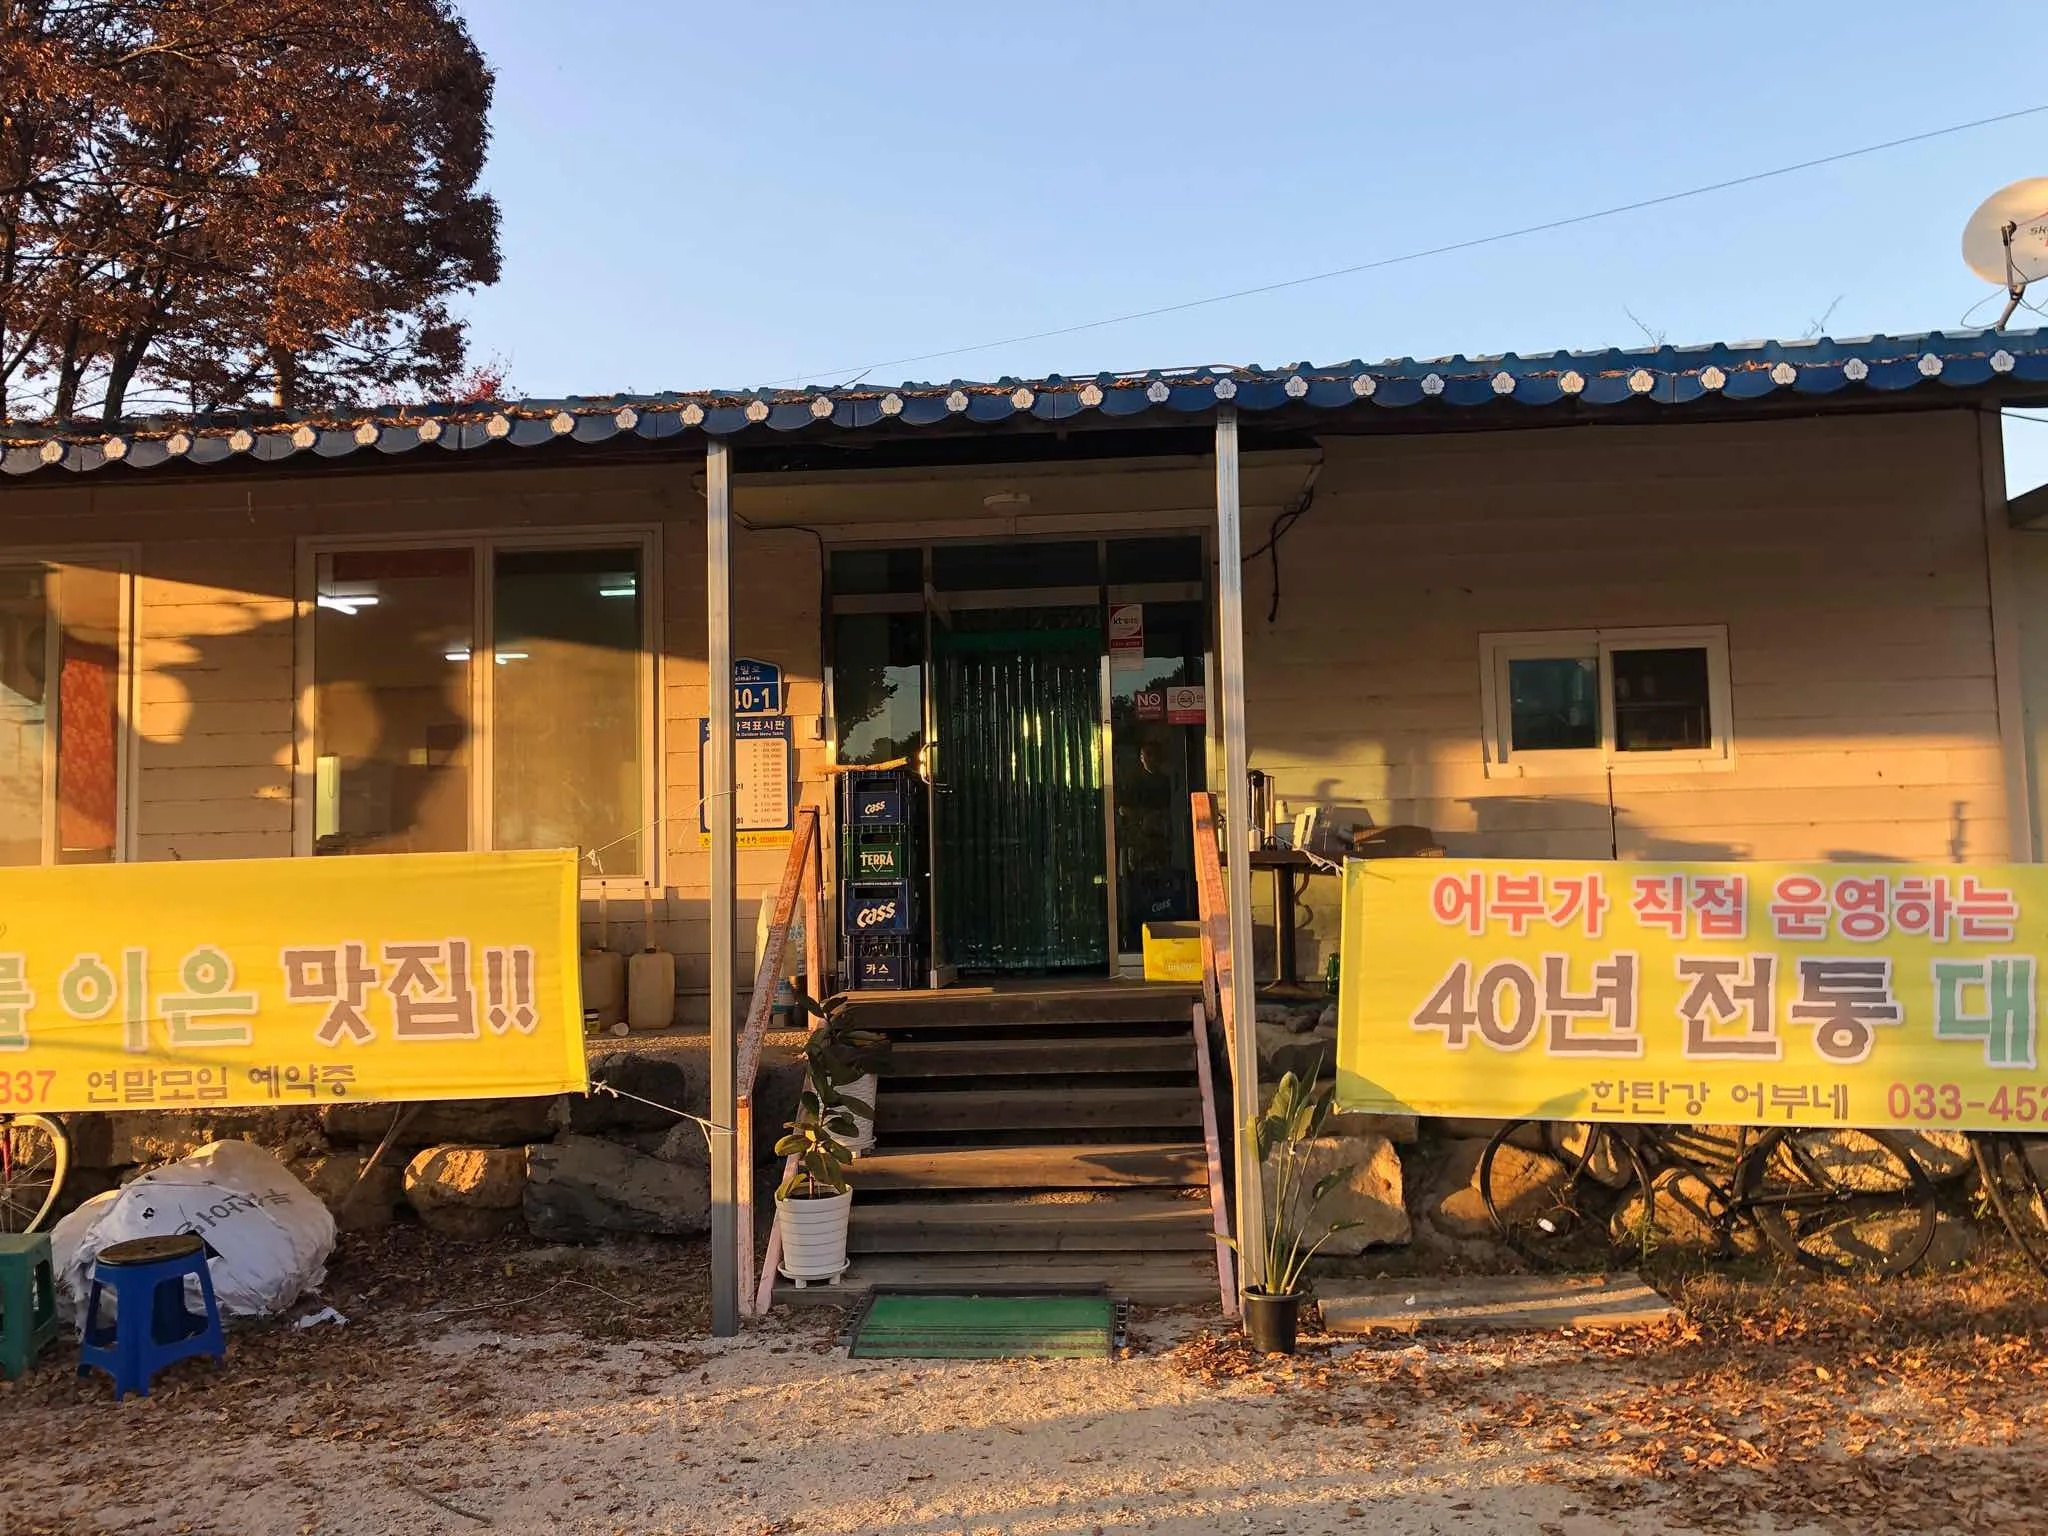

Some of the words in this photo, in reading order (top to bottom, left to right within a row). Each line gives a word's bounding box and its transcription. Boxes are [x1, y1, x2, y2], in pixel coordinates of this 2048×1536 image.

[860, 850, 894, 867] TERRA
[1432, 873, 1608, 935] 어부가
[1632, 875, 1744, 937] 직접
[1770, 875, 2016, 939] 운영하는
[865, 963, 889, 975] 카스
[61, 946, 257, 1052] 이은
[283, 940, 537, 1044] 맛집!!
[1413, 955, 1639, 1053] 40년
[1679, 956, 1899, 1060] 전통
[87, 1065, 229, 1104] 연말모임
[247, 1064, 357, 1099] 예약중
[1590, 1080, 1711, 1116] 한탄강
[1731, 1082, 1849, 1121] 어부네
